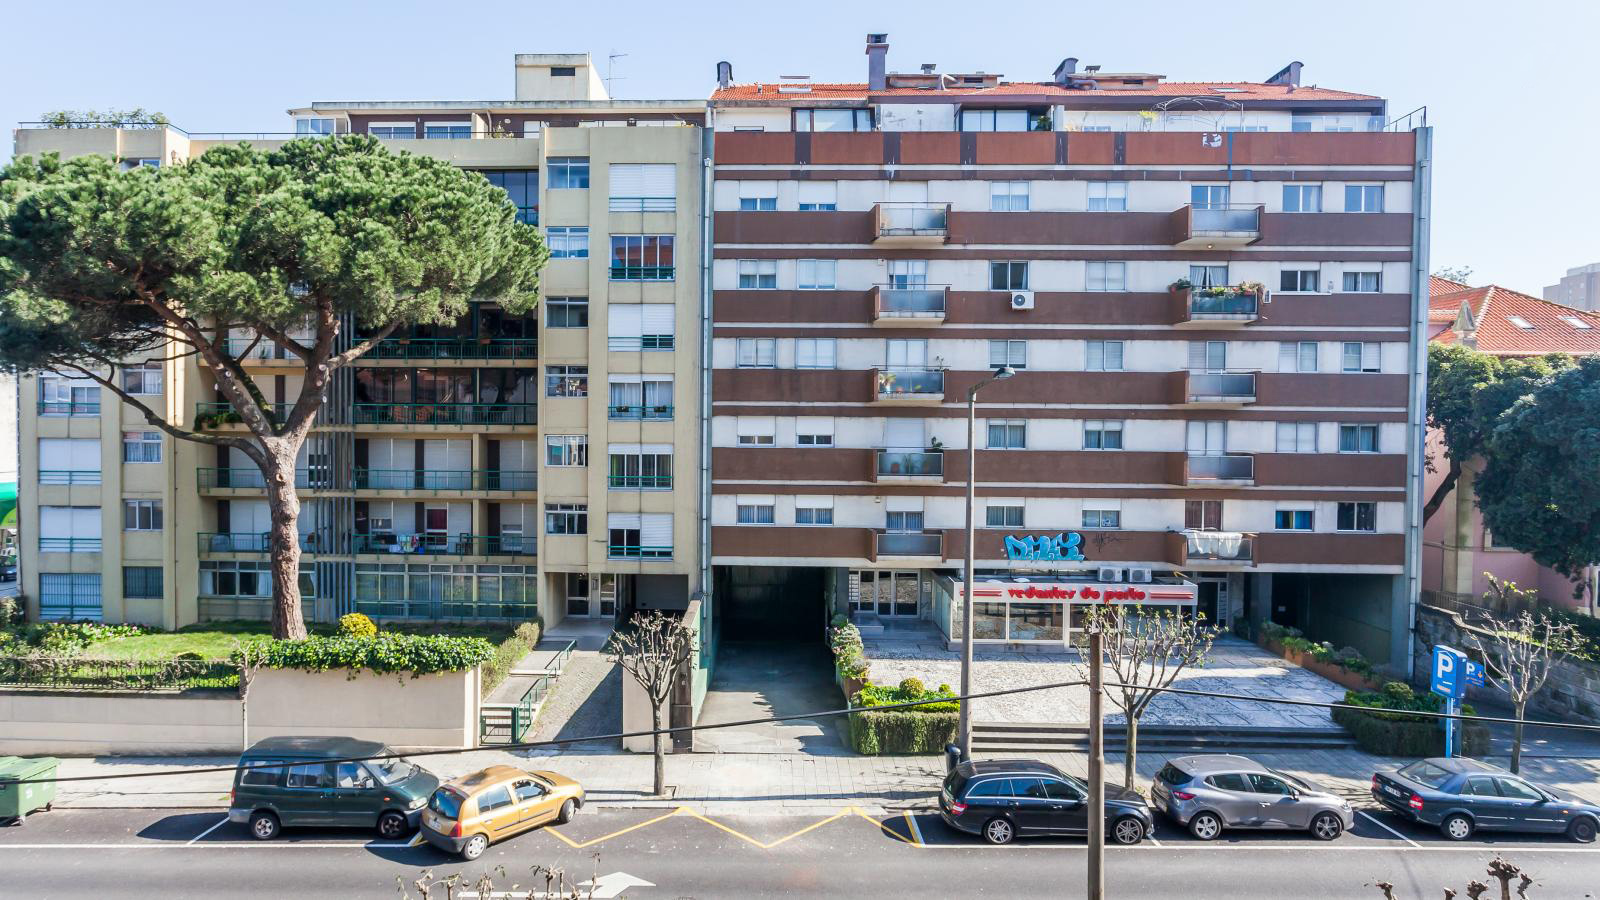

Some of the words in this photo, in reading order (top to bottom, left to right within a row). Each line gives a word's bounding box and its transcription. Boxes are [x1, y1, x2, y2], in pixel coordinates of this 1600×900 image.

[1080, 587, 1100, 600] do
[1437, 652, 1453, 678] P
[1466, 662, 1475, 675] P
